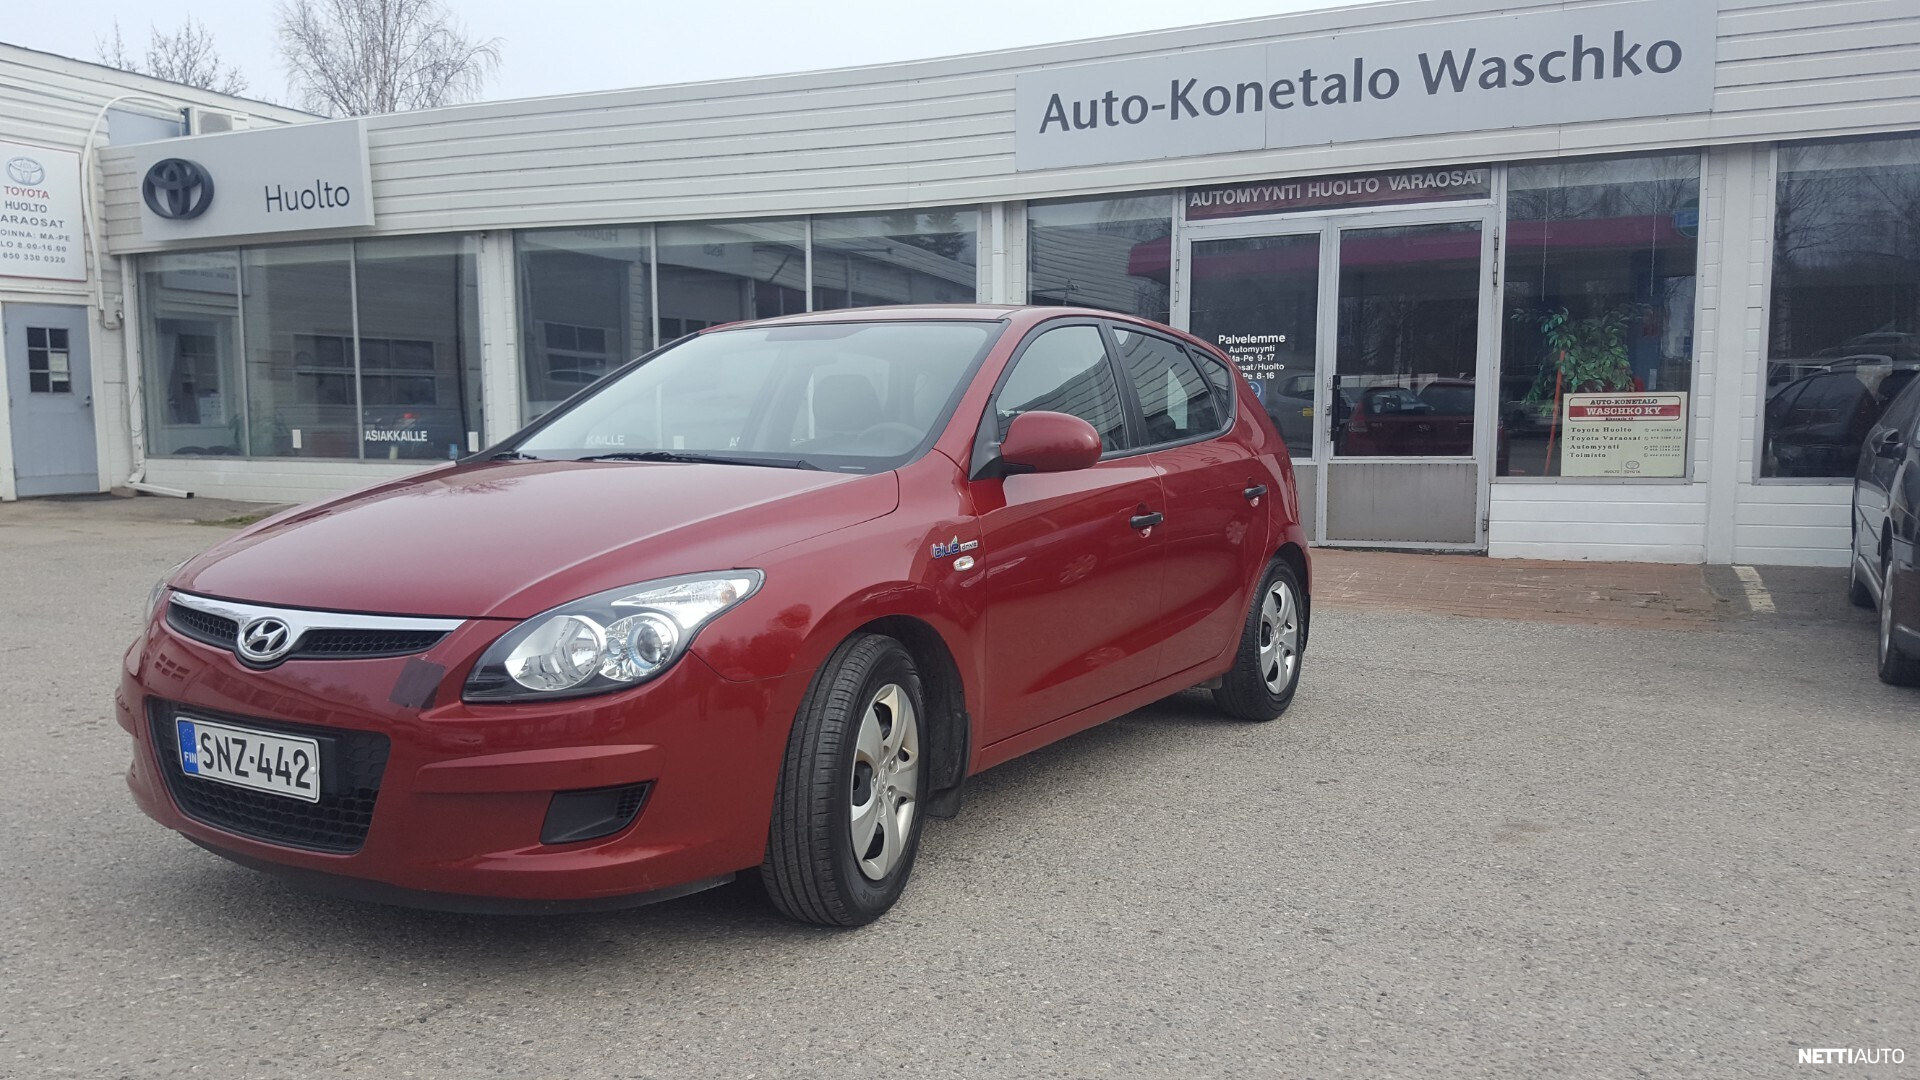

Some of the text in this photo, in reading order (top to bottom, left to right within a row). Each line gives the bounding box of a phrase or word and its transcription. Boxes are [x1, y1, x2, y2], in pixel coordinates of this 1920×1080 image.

[1038, 29, 1683, 135] Auto-Konetalo Waschko
[4, 185, 50, 199] TOYOTA
[1189, 169, 1484, 208] AUTOMYYNTI HUOLTO VARAOSAT
[265, 178, 350, 213] Huolto
[5, 200, 48, 213] HUOLTO
[1218, 334, 1286, 344] Palvelemme
[1229, 345, 1275, 354] Automyynti
[1257, 354, 1275, 362] 9-17
[1256, 372, 1275, 380] 8-16
[1590, 398, 1658, 406] AUTO-KONETALO
[1586, 406, 1662, 416] WASCHKO KY
[365, 430, 428, 442] ASIAKKAILLE
[184, 751, 197, 765] FIN
[200, 732, 311, 790] SNZ-442
